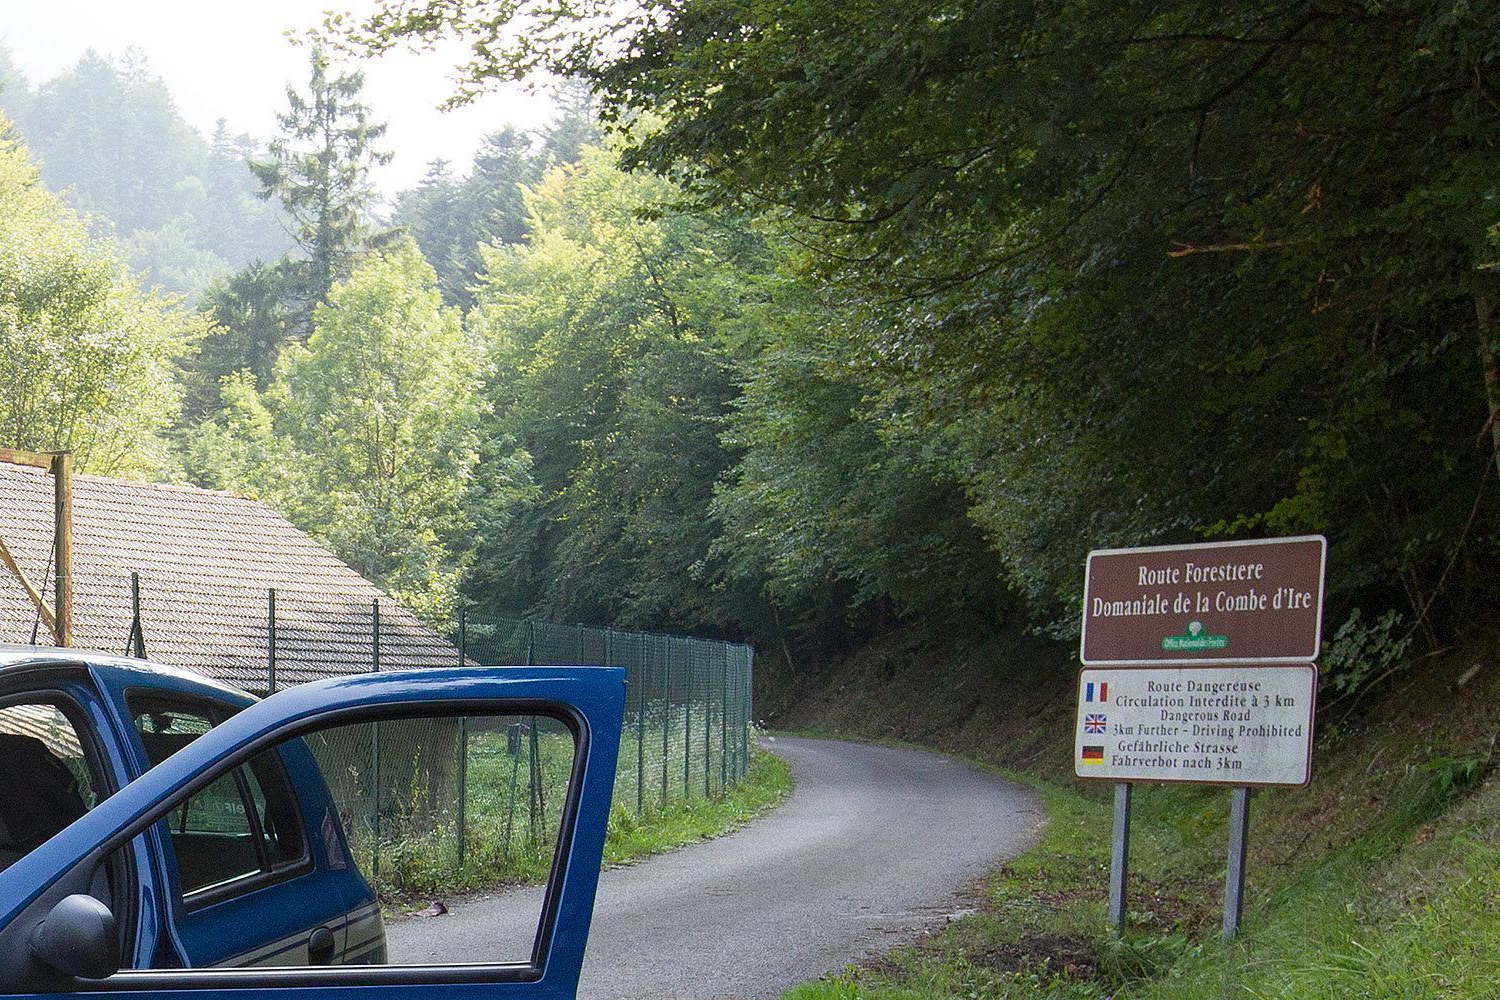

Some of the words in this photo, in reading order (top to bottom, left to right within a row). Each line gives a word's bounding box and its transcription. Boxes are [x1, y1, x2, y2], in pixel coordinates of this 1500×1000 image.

[1138, 566, 1180, 586] Route
[1092, 594, 1169, 617] Domaniale
[1173, 592, 1191, 614] de
[1196, 592, 1210, 613] la
[1215, 589, 1267, 612] Combe
[1272, 587, 1311, 610] d'Ire
[1147, 681, 1182, 692] Route
[1187, 681, 1261, 695] Dangereuse
[1115, 696, 1184, 707] Circulation
[1189, 695, 1247, 707] Interdite
[1251, 694, 1258, 707] à
[1263, 695, 1270, 708] 3
[1275, 694, 1295, 707] km
[1160, 710, 1219, 724] Dangerous
[1223, 709, 1251, 721] Road
[1112, 723, 1134, 736] 3km
[1138, 724, 1179, 736] Further
[1192, 725, 1234, 740] Driving
[1239, 725, 1302, 737] Prohibited
[1118, 740, 1190, 753] Gefährliche
[1193, 741, 1238, 753] Strasse
[1111, 755, 1178, 768] Fahrverbot
[1182, 756, 1212, 768] nach
[1216, 757, 1243, 770] 3km
